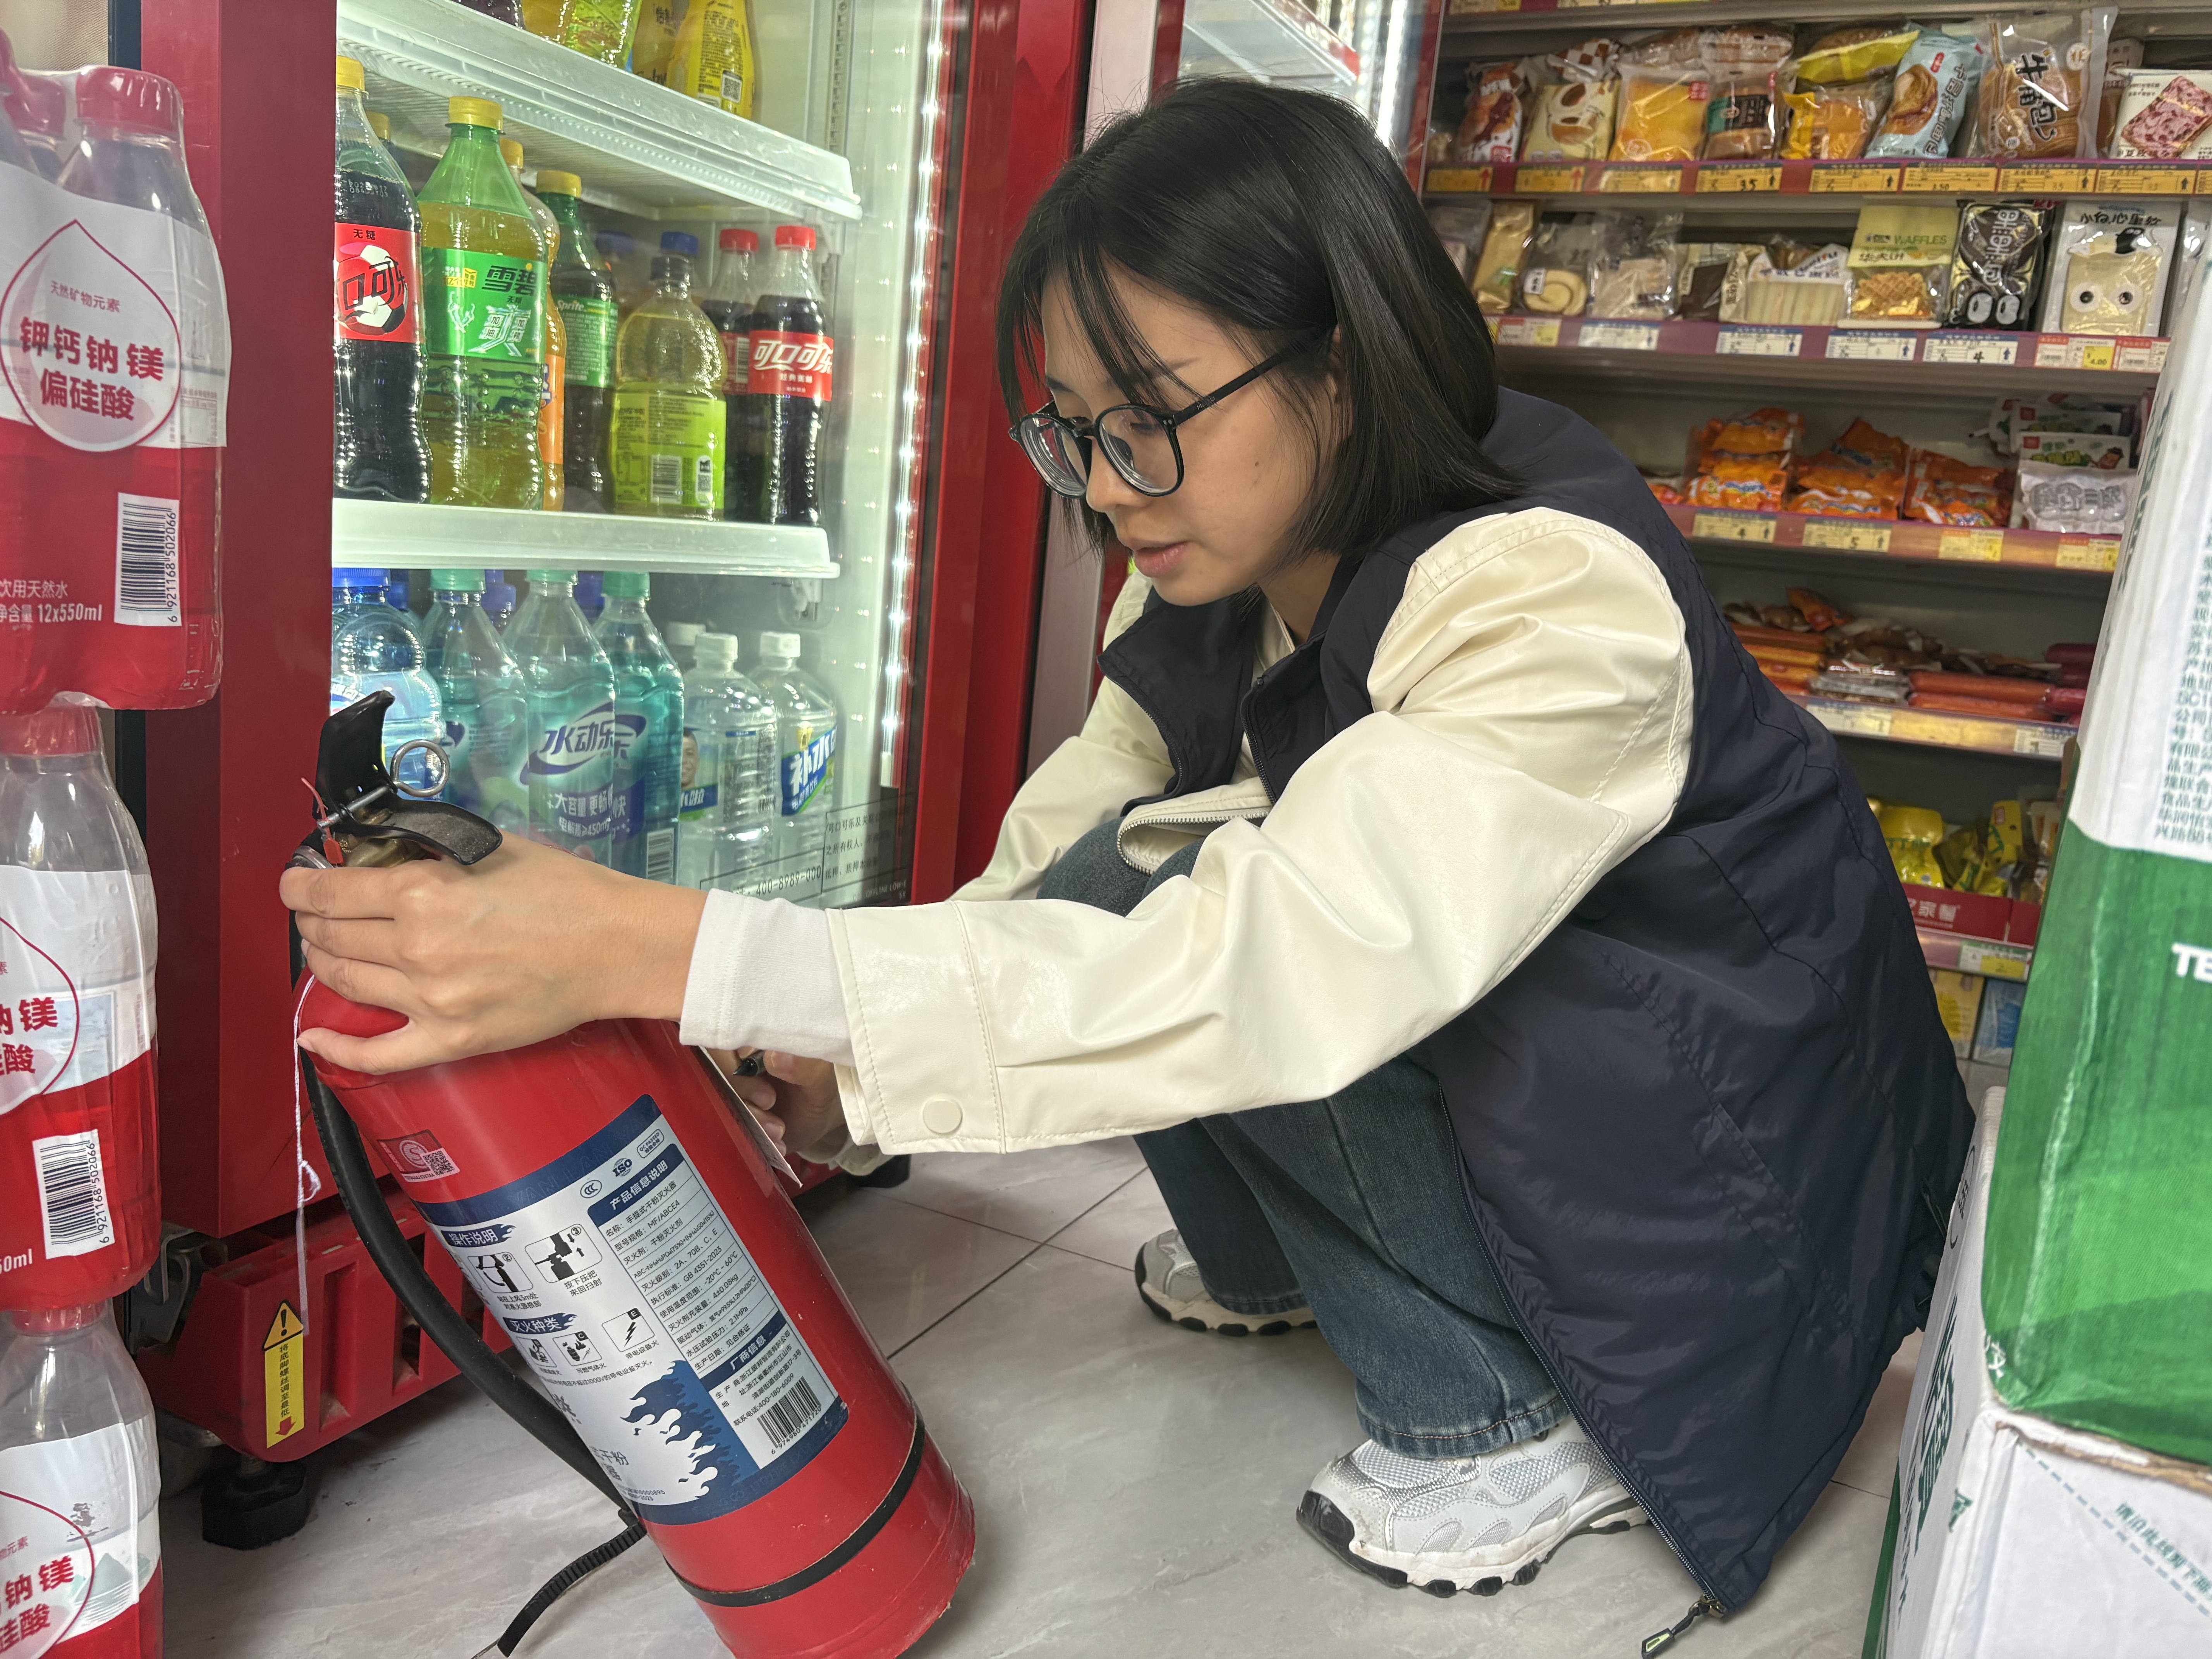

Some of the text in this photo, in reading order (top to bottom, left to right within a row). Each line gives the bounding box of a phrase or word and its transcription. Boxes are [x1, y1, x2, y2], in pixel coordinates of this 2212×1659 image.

[1894, 235, 1948, 245] WAFFLES
[334, 256, 408, 310] 口可乐
[482, 265, 538, 296] 雪碧
[51, 281, 120, 313] 天然矿物元素
[557, 299, 584, 311] Sprite
[753, 340, 834, 374] 可口可乐
[40, 369, 135, 421] 偏硅酸
[646, 1132, 660, 1146] PASSED
[612, 1159, 632, 1177] ISO
[610, 1160, 668, 1210] 产品信息说明
[448, 1228, 499, 1246] 操作说明
[0, 1248, 33, 1273] 0ml
[564, 1270, 598, 1289] 按下压把
[569, 1278, 602, 1297] 来回扫射
[510, 1317, 562, 1333] 灭火种类
[625, 1340, 659, 1359] 带电设备火
[730, 1334, 767, 1370] 厂商信息
[576, 1363, 607, 1374] 可燃气体火
[280, 1343, 290, 1418] 将底脚螺丝调至最低
[0, 1555, 75, 1613] 钠镁
